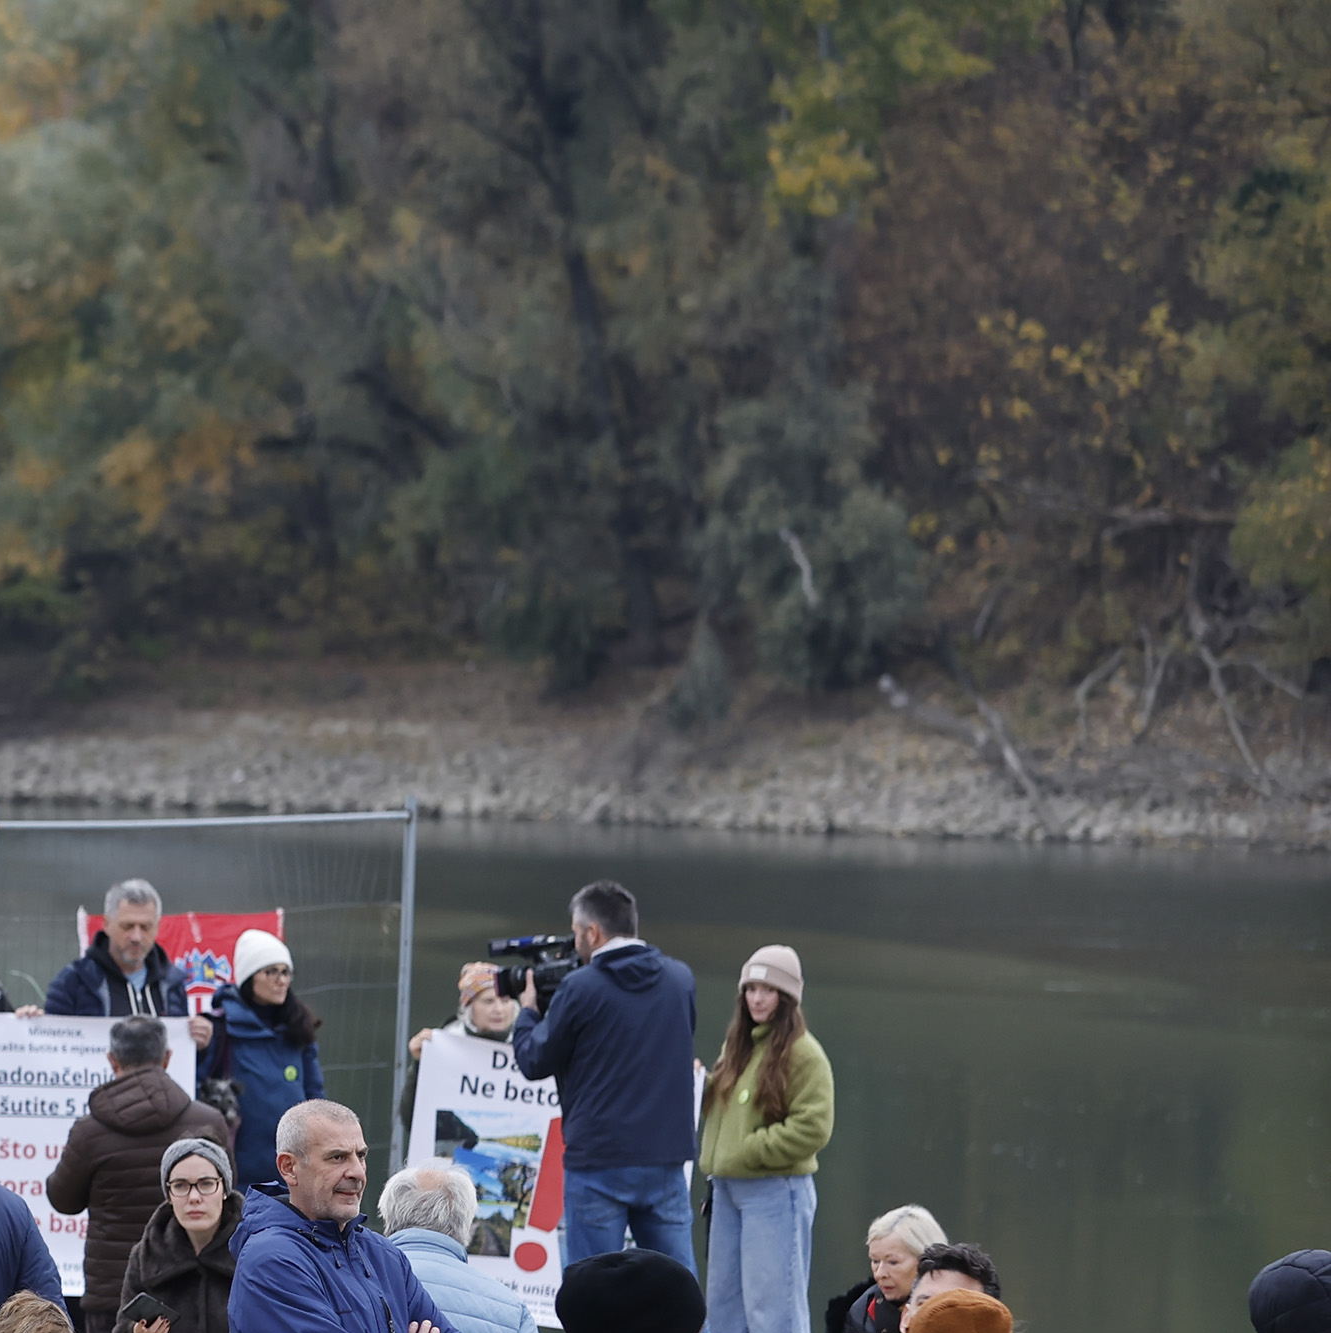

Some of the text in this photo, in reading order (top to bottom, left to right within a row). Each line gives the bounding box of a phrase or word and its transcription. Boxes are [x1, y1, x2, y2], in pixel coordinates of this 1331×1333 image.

[460, 1074, 560, 1107] Ne beto
[0, 1095, 59, 1115] šutite
[65, 1097, 75, 1115] 5
[50, 1213, 89, 1239] bag
[523, 1283, 556, 1297] uništ
